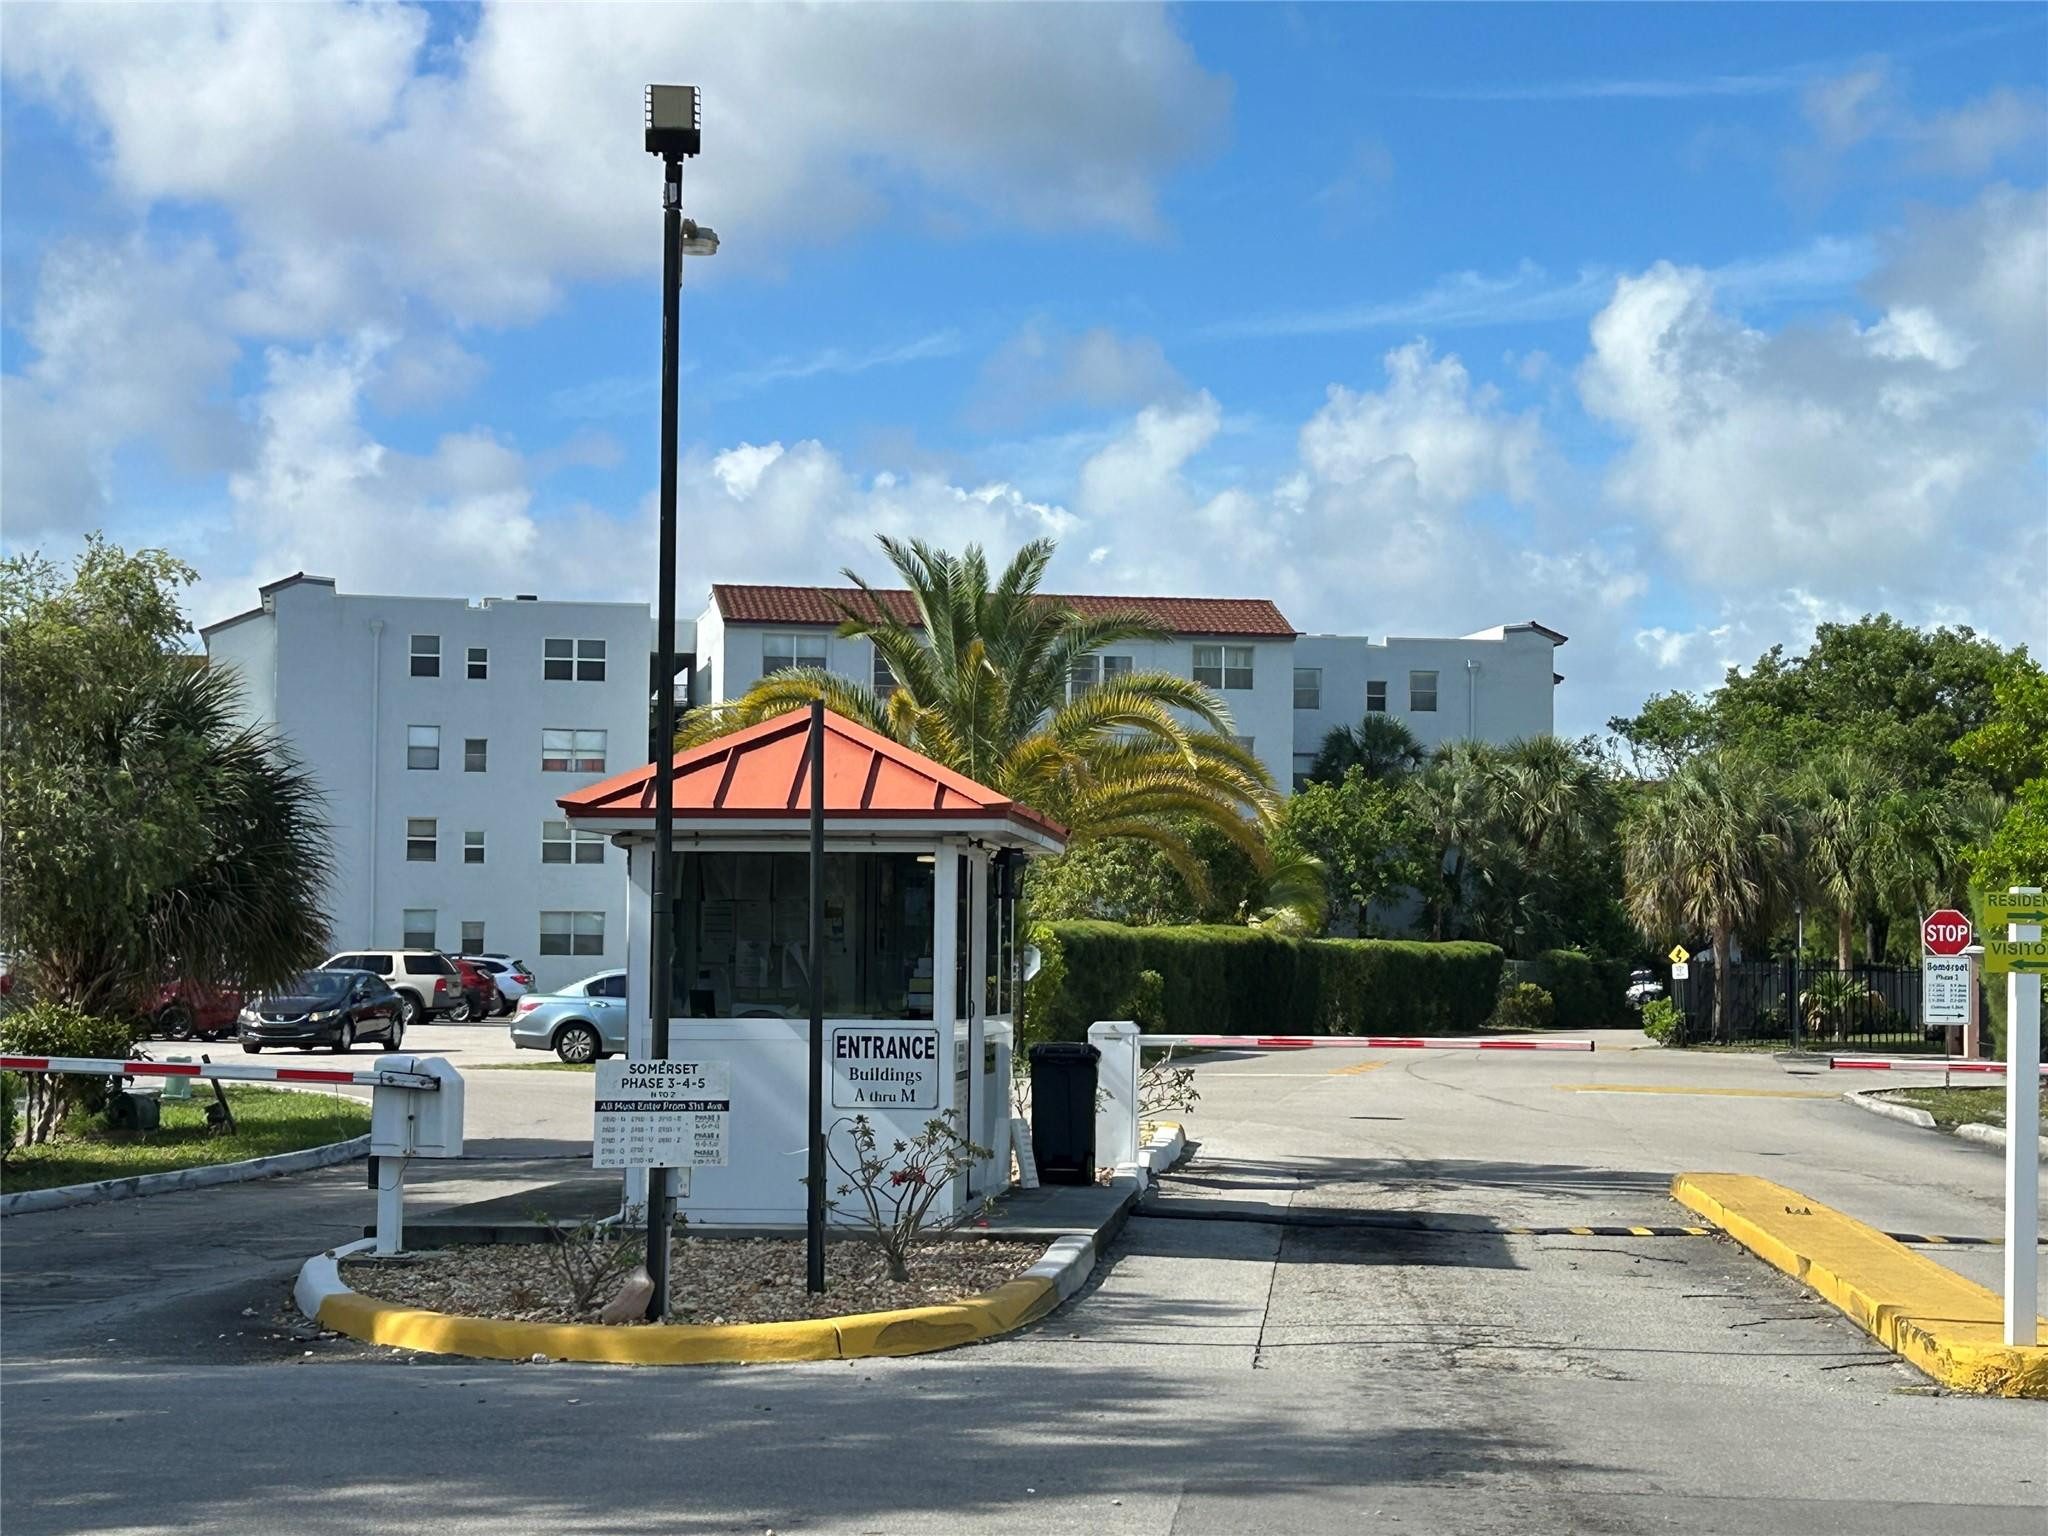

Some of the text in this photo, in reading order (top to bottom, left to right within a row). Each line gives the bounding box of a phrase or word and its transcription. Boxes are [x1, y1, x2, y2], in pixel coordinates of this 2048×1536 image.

[1926, 924, 1968, 942] STOP
[1927, 962, 1969, 972] Somerset
[836, 1035, 936, 1060] ENTRANCE
[629, 1063, 699, 1075] SOMERSET
[849, 1066, 922, 1086] Buildings
[621, 1078, 706, 1089] PHASE 3-4-5
[854, 1088, 916, 1103] A thru M
[614, 1101, 636, 1111] Must
[637, 1101, 660, 1111] Enter
[662, 1101, 686, 1111] From
